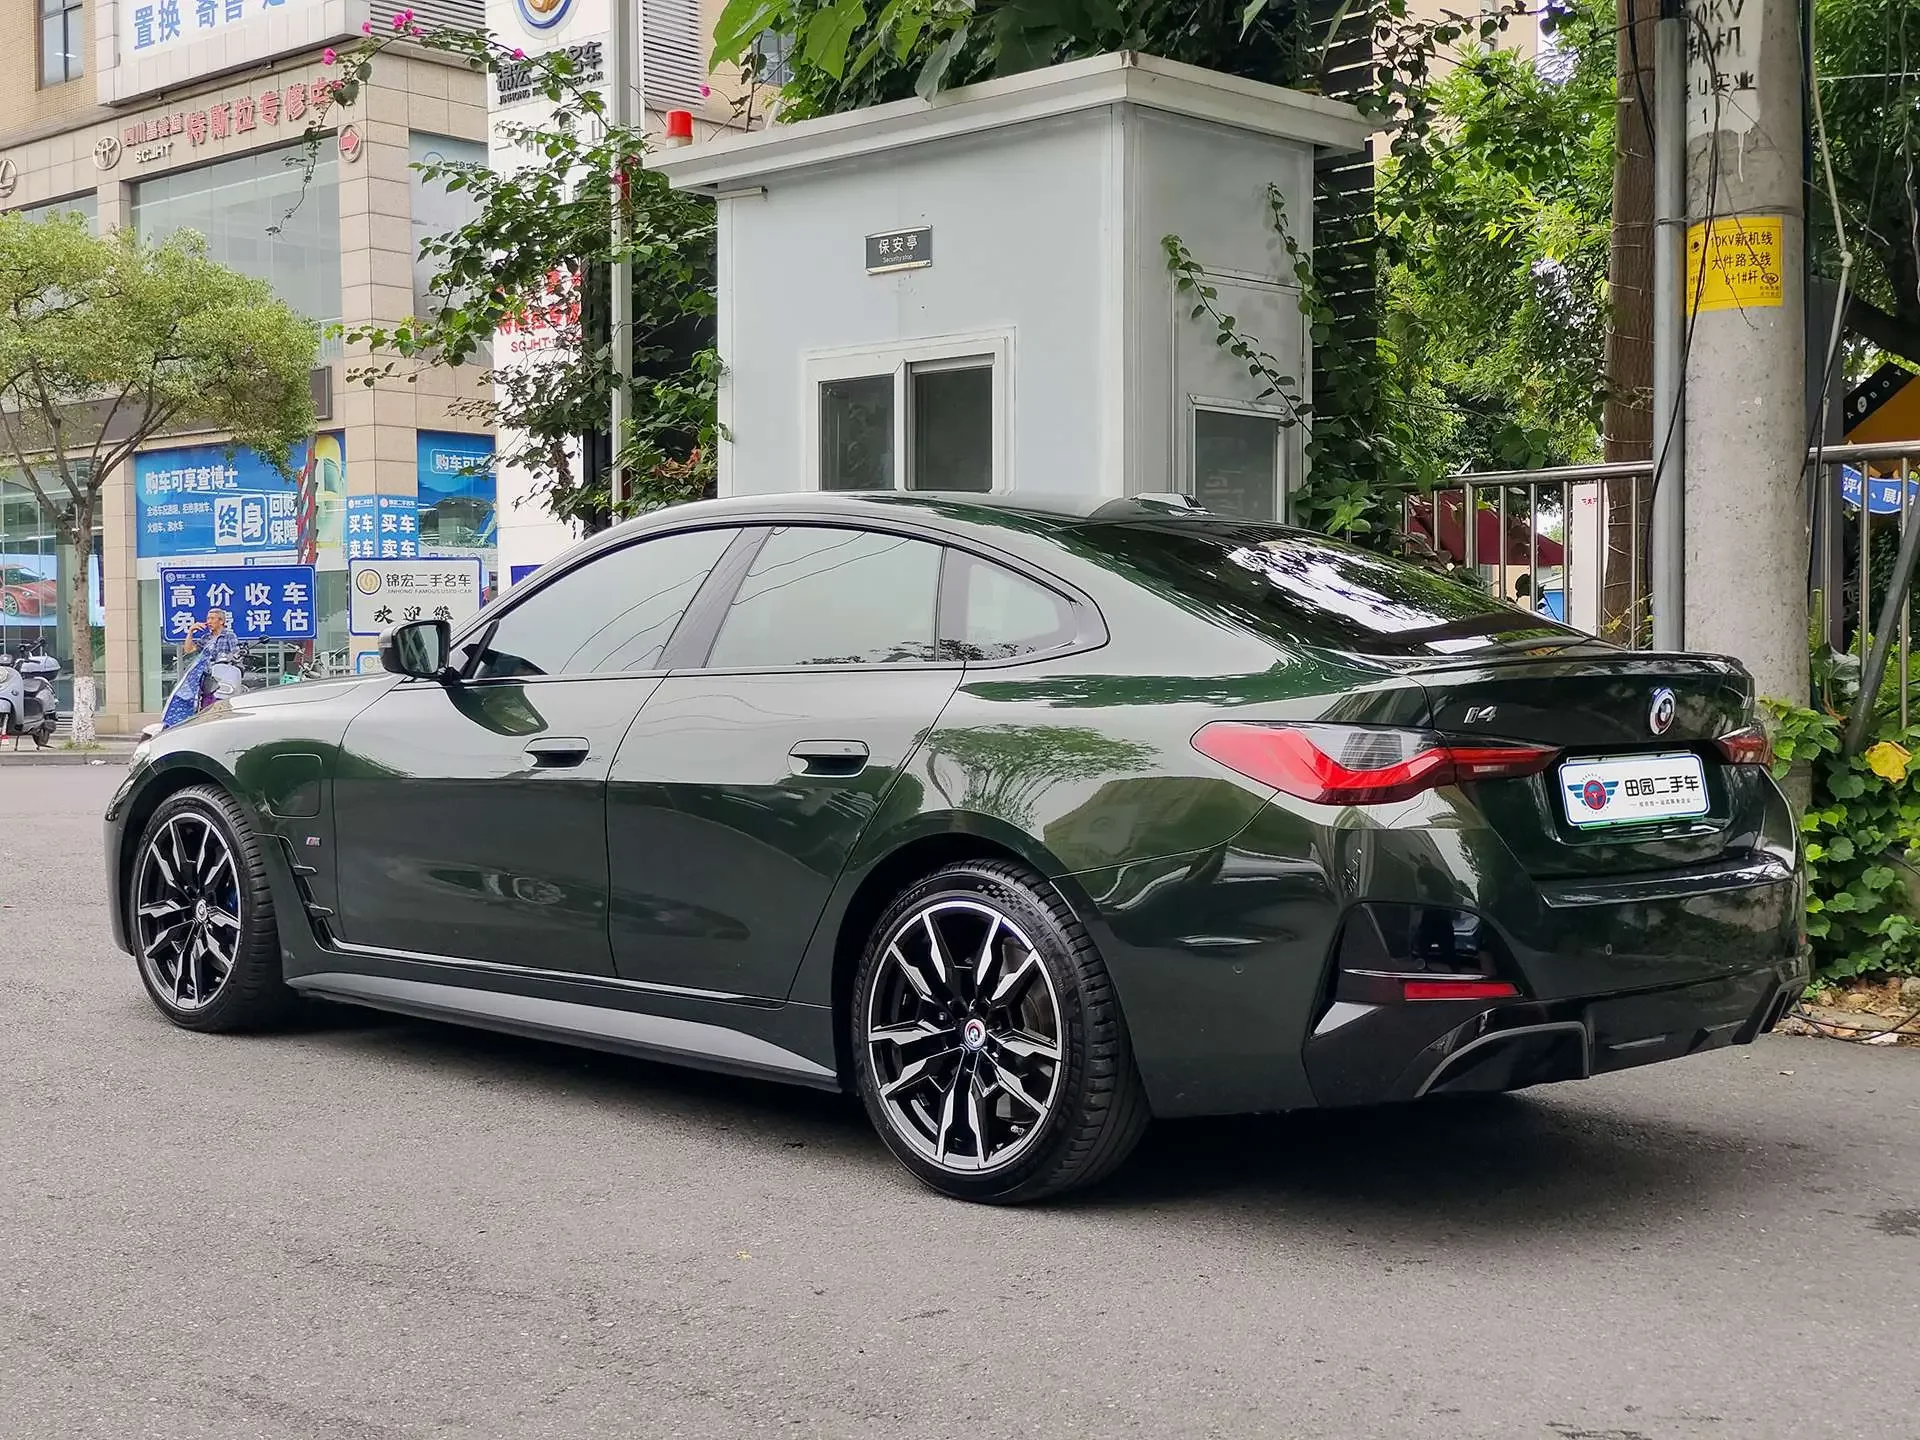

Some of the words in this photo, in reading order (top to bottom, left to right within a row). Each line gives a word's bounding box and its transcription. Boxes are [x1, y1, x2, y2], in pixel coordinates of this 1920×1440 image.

[134, 0, 181, 49] 置换
[185, 76, 345, 146] 特斯拉专修中
[878, 234, 918, 255] 保安亭
[145, 464, 239, 495] 购车可享查博士
[218, 502, 264, 539] 终身
[349, 513, 374, 534] 买车
[381, 513, 416, 534] 买车
[349, 538, 374, 558] 卖车
[381, 539, 416, 558] 卖车
[385, 573, 471, 588] 锦宏二手名车
[169, 581, 309, 608] 高价收车
[1624, 775, 1700, 797] 田园二手车
